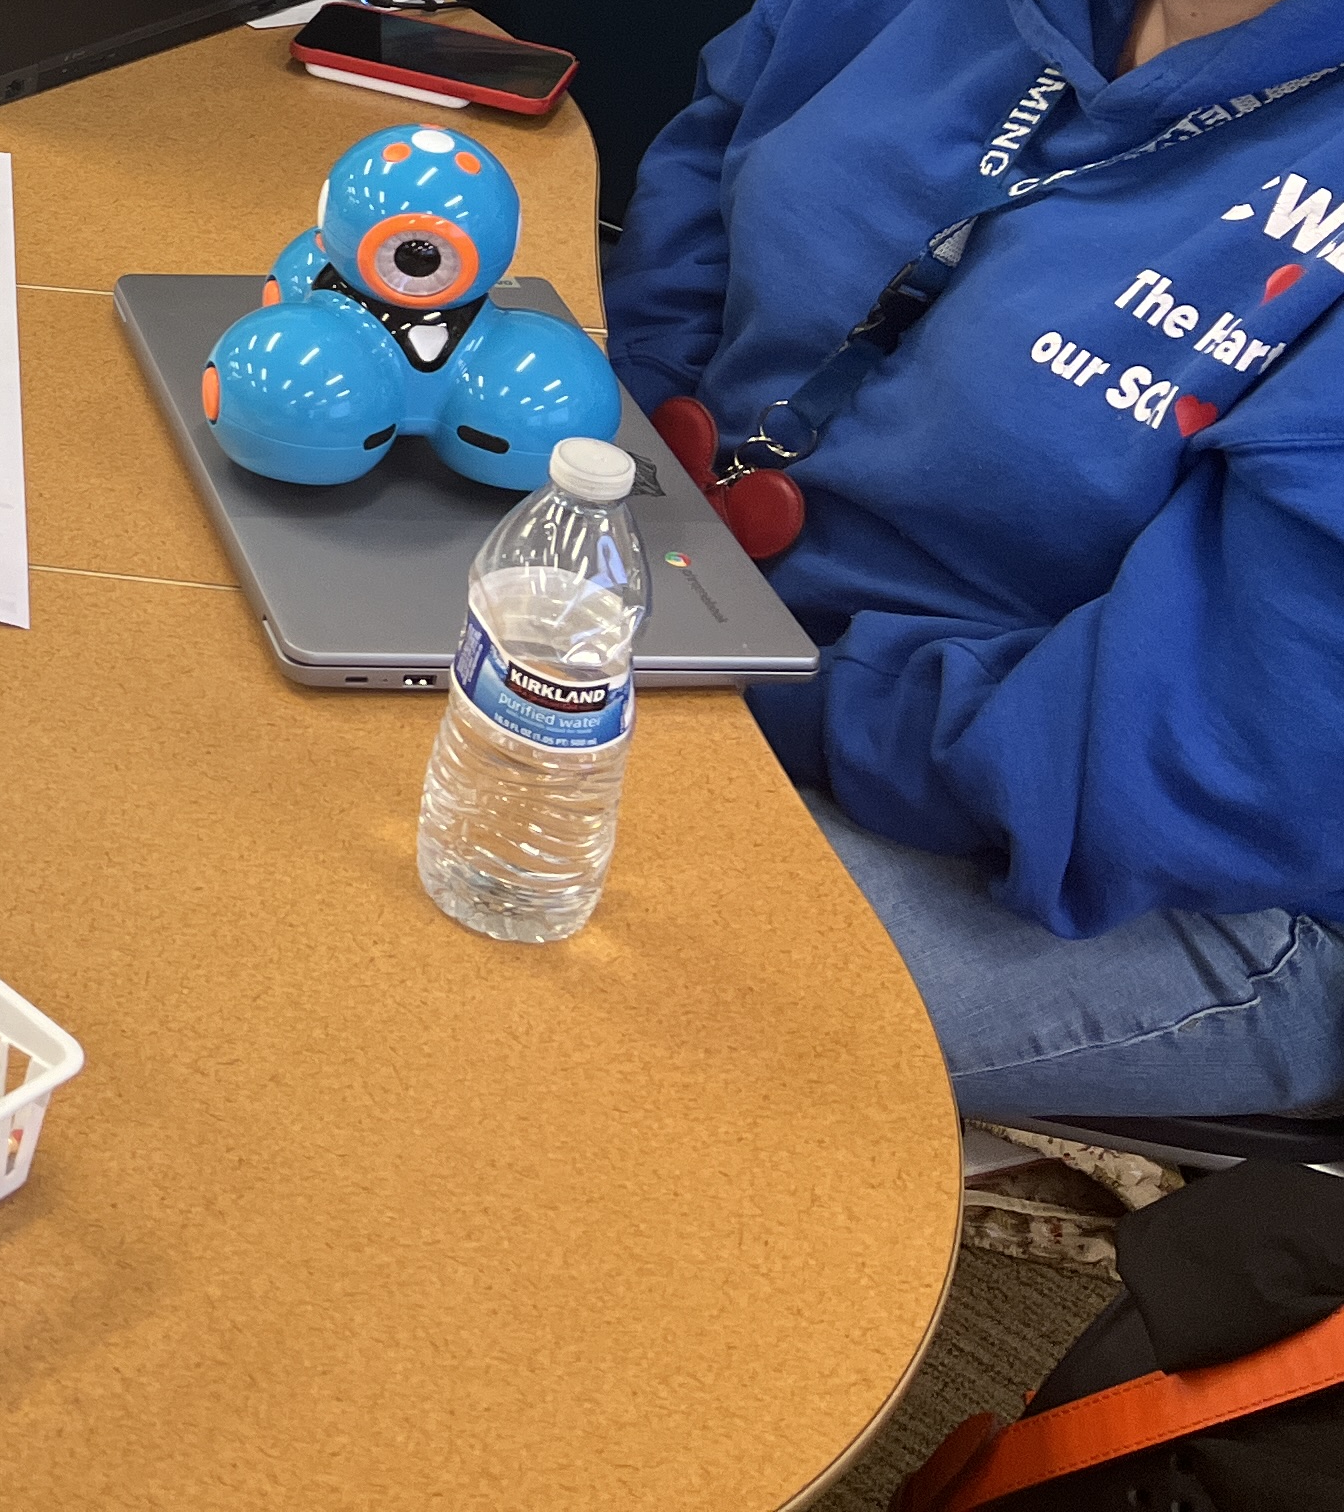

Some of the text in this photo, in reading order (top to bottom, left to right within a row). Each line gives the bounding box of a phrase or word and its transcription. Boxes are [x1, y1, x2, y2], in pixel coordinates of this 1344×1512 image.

[980, 68, 1066, 176] MING
[1264, 173, 1344, 274] W
[1115, 269, 1199, 338] The
[1030, 331, 1110, 387] our
[499, 692, 555, 726] purified
[559, 716, 601, 729] water
[511, 669, 606, 704] KIRKLAND
